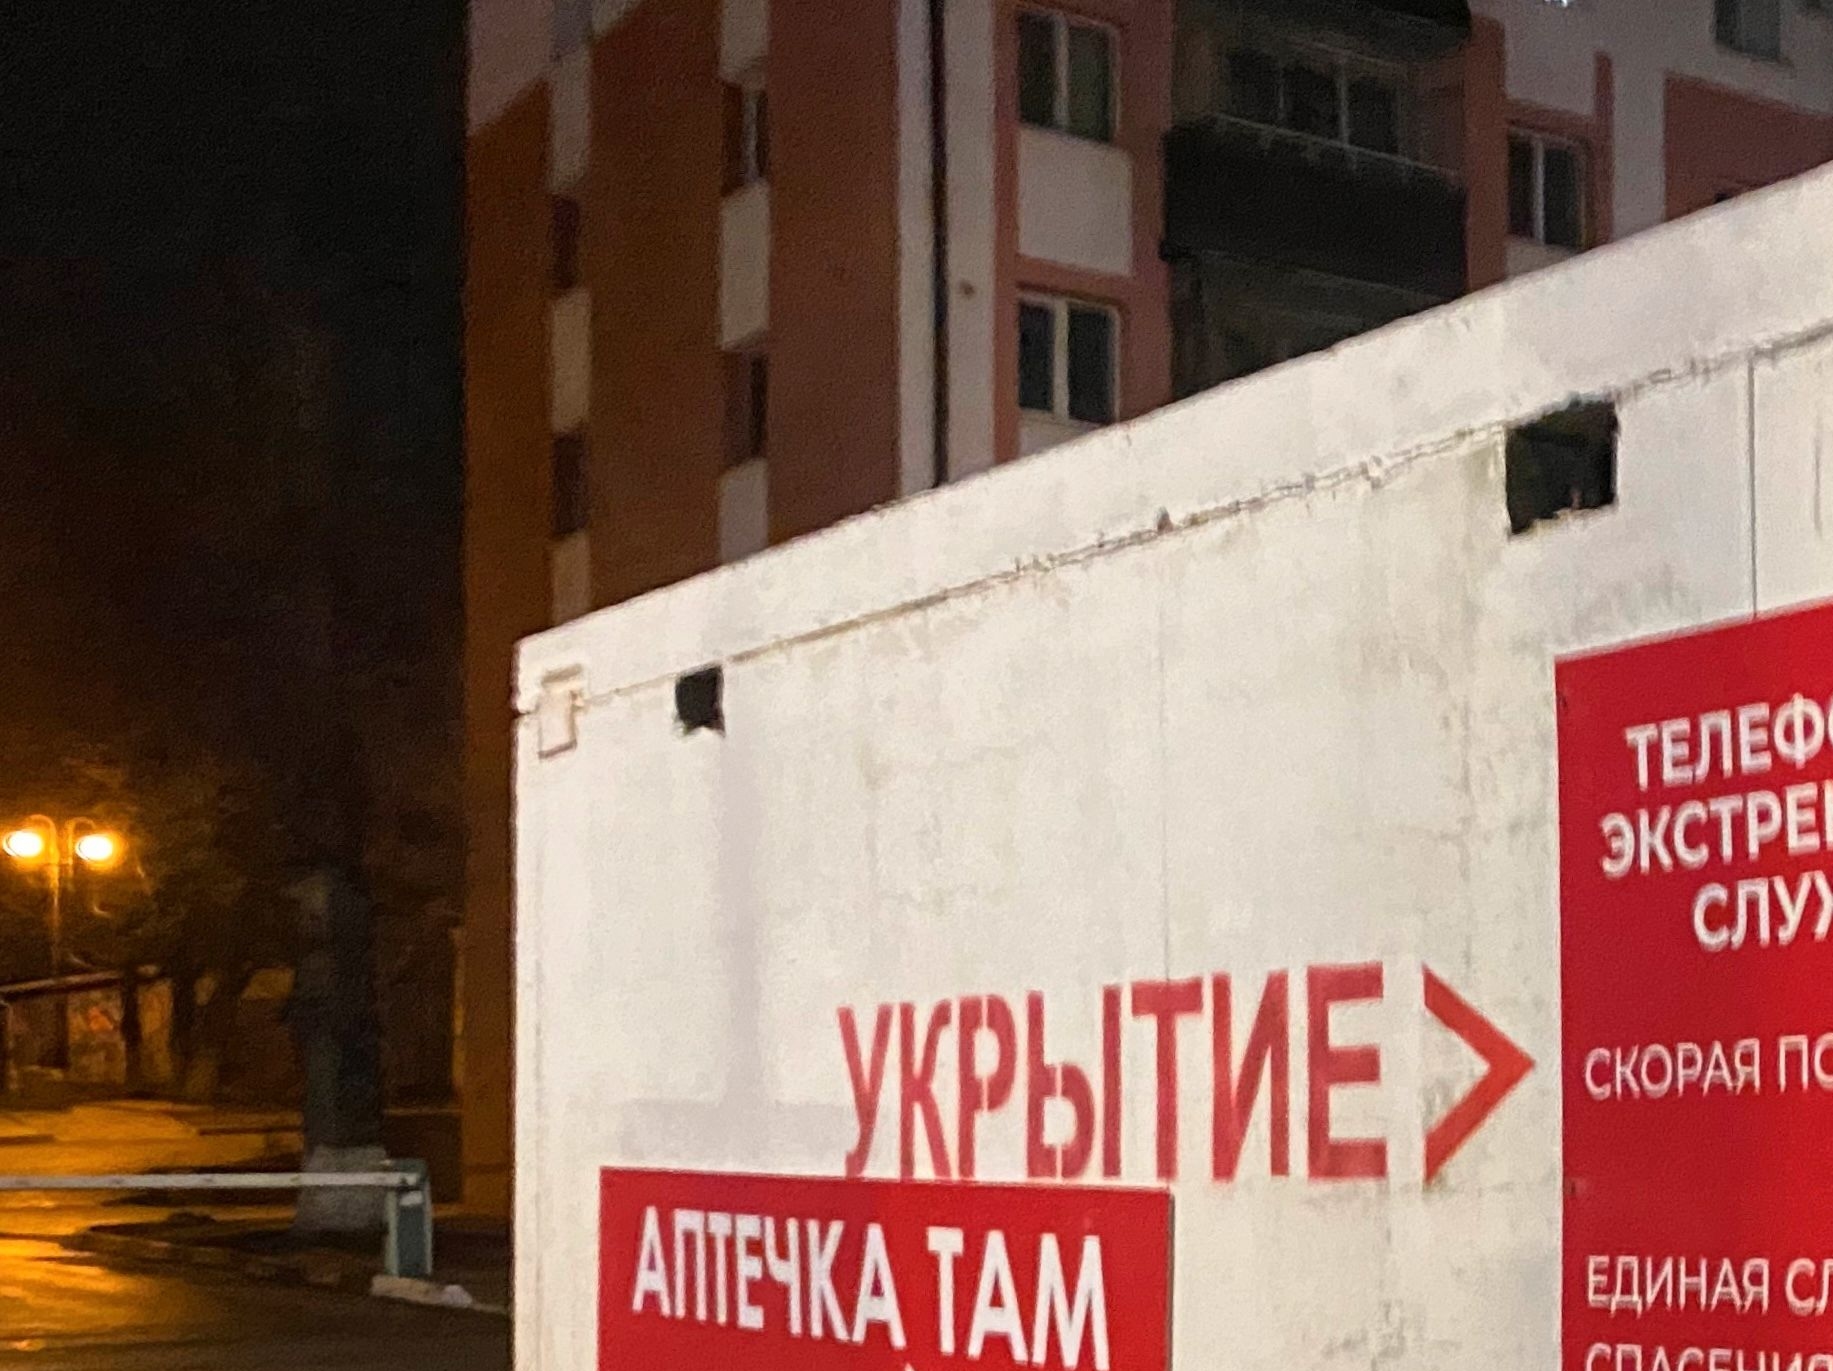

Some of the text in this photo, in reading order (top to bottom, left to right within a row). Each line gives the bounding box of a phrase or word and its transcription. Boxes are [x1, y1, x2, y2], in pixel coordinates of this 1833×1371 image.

[837, 961, 1387, 1182] УКРЫТИЕ
[1584, 1037, 1761, 1100] СКОРАЯ
[631, 1205, 907, 1350] АПТЕЧКА
[1587, 1255, 1770, 1317] ЕДИНАЯ
